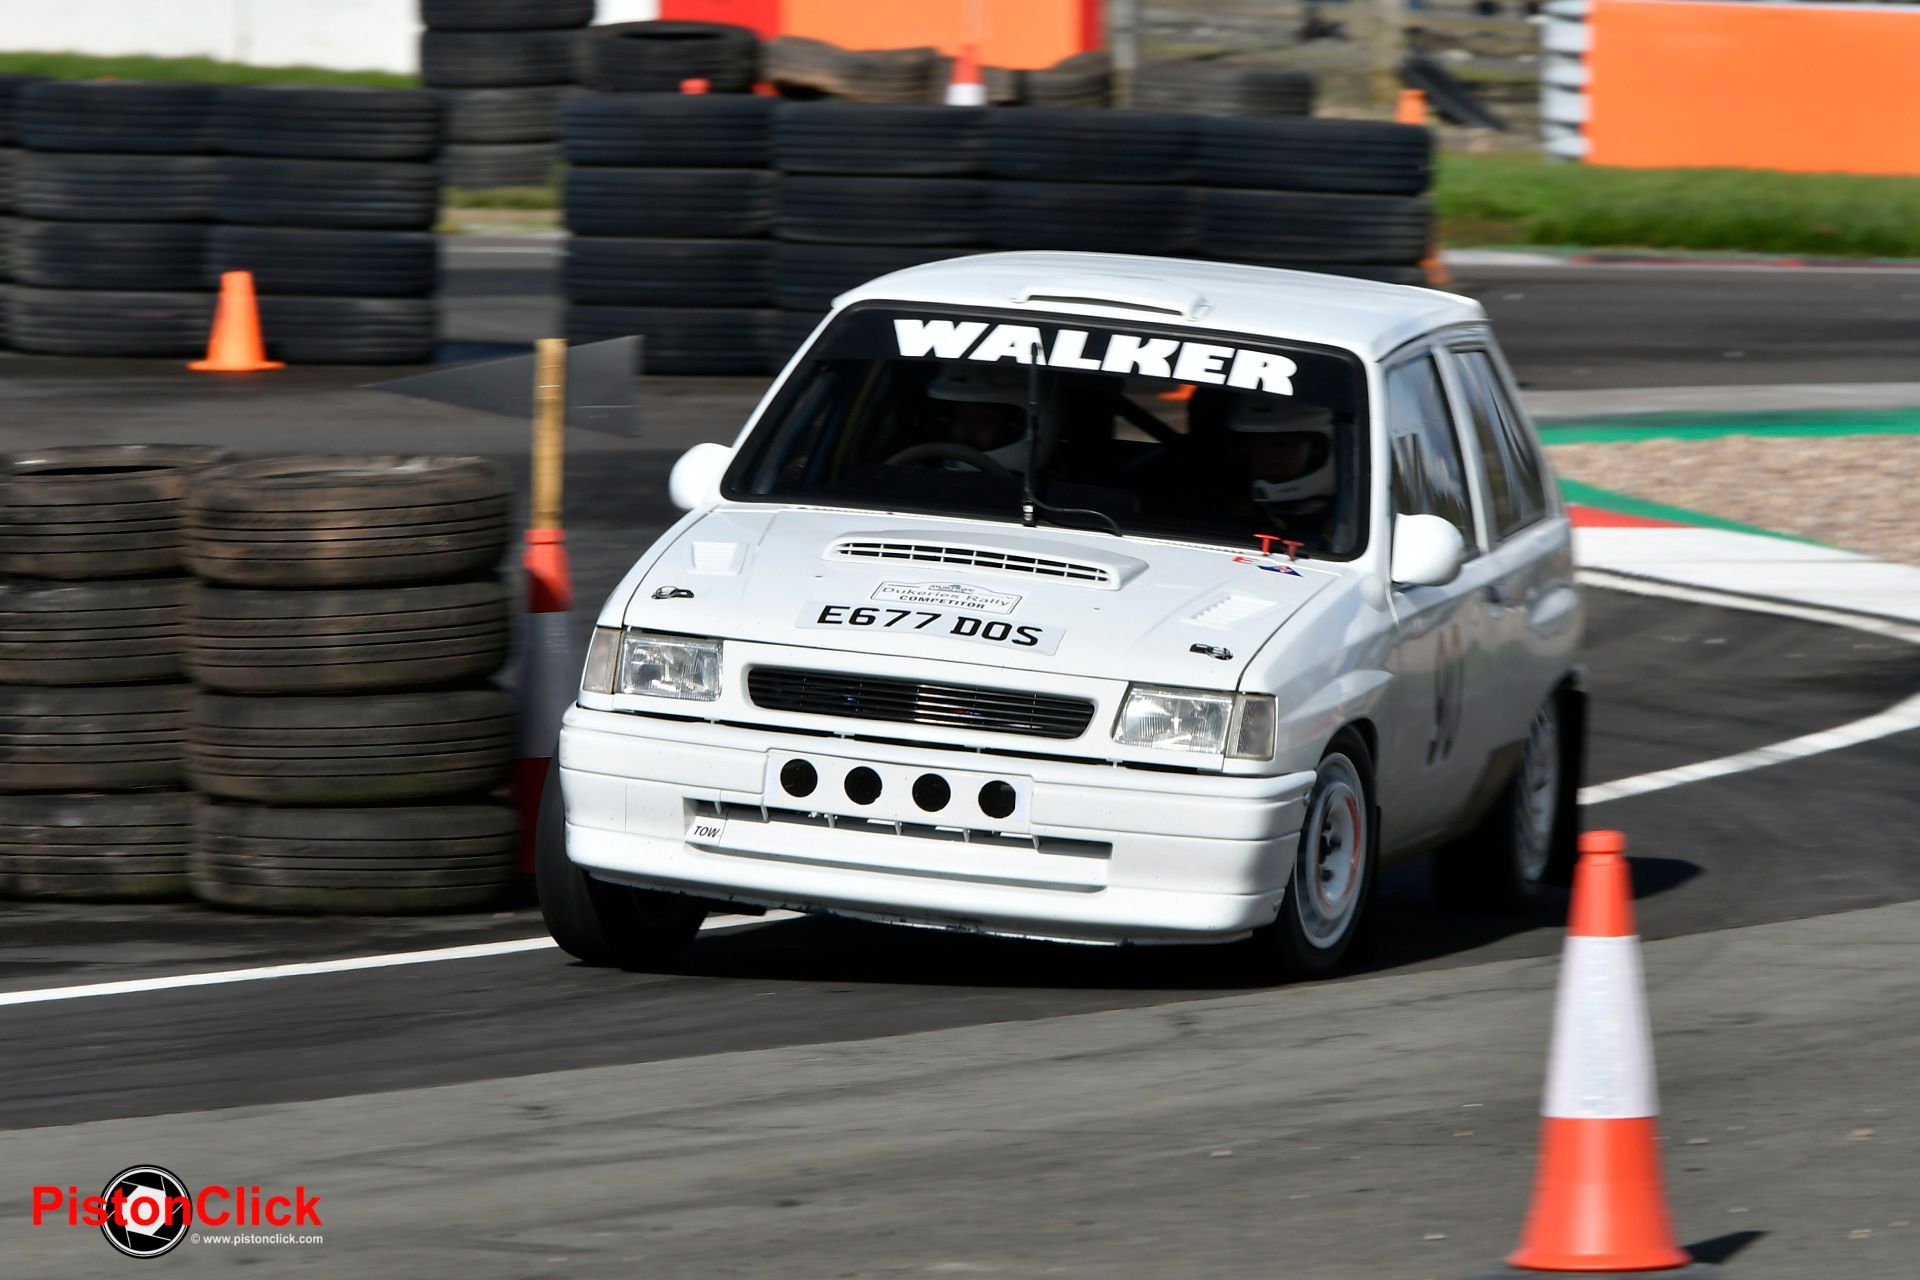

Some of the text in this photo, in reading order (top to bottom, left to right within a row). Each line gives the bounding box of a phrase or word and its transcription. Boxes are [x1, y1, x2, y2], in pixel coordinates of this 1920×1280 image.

[893, 319, 1298, 397] WALKER
[882, 587, 960, 600] Dukeries
[966, 595, 1010, 607] Rally
[899, 595, 985, 609] COMPETITOR
[816, 604, 1044, 647] E677 DOS
[693, 825, 721, 838] TOW
